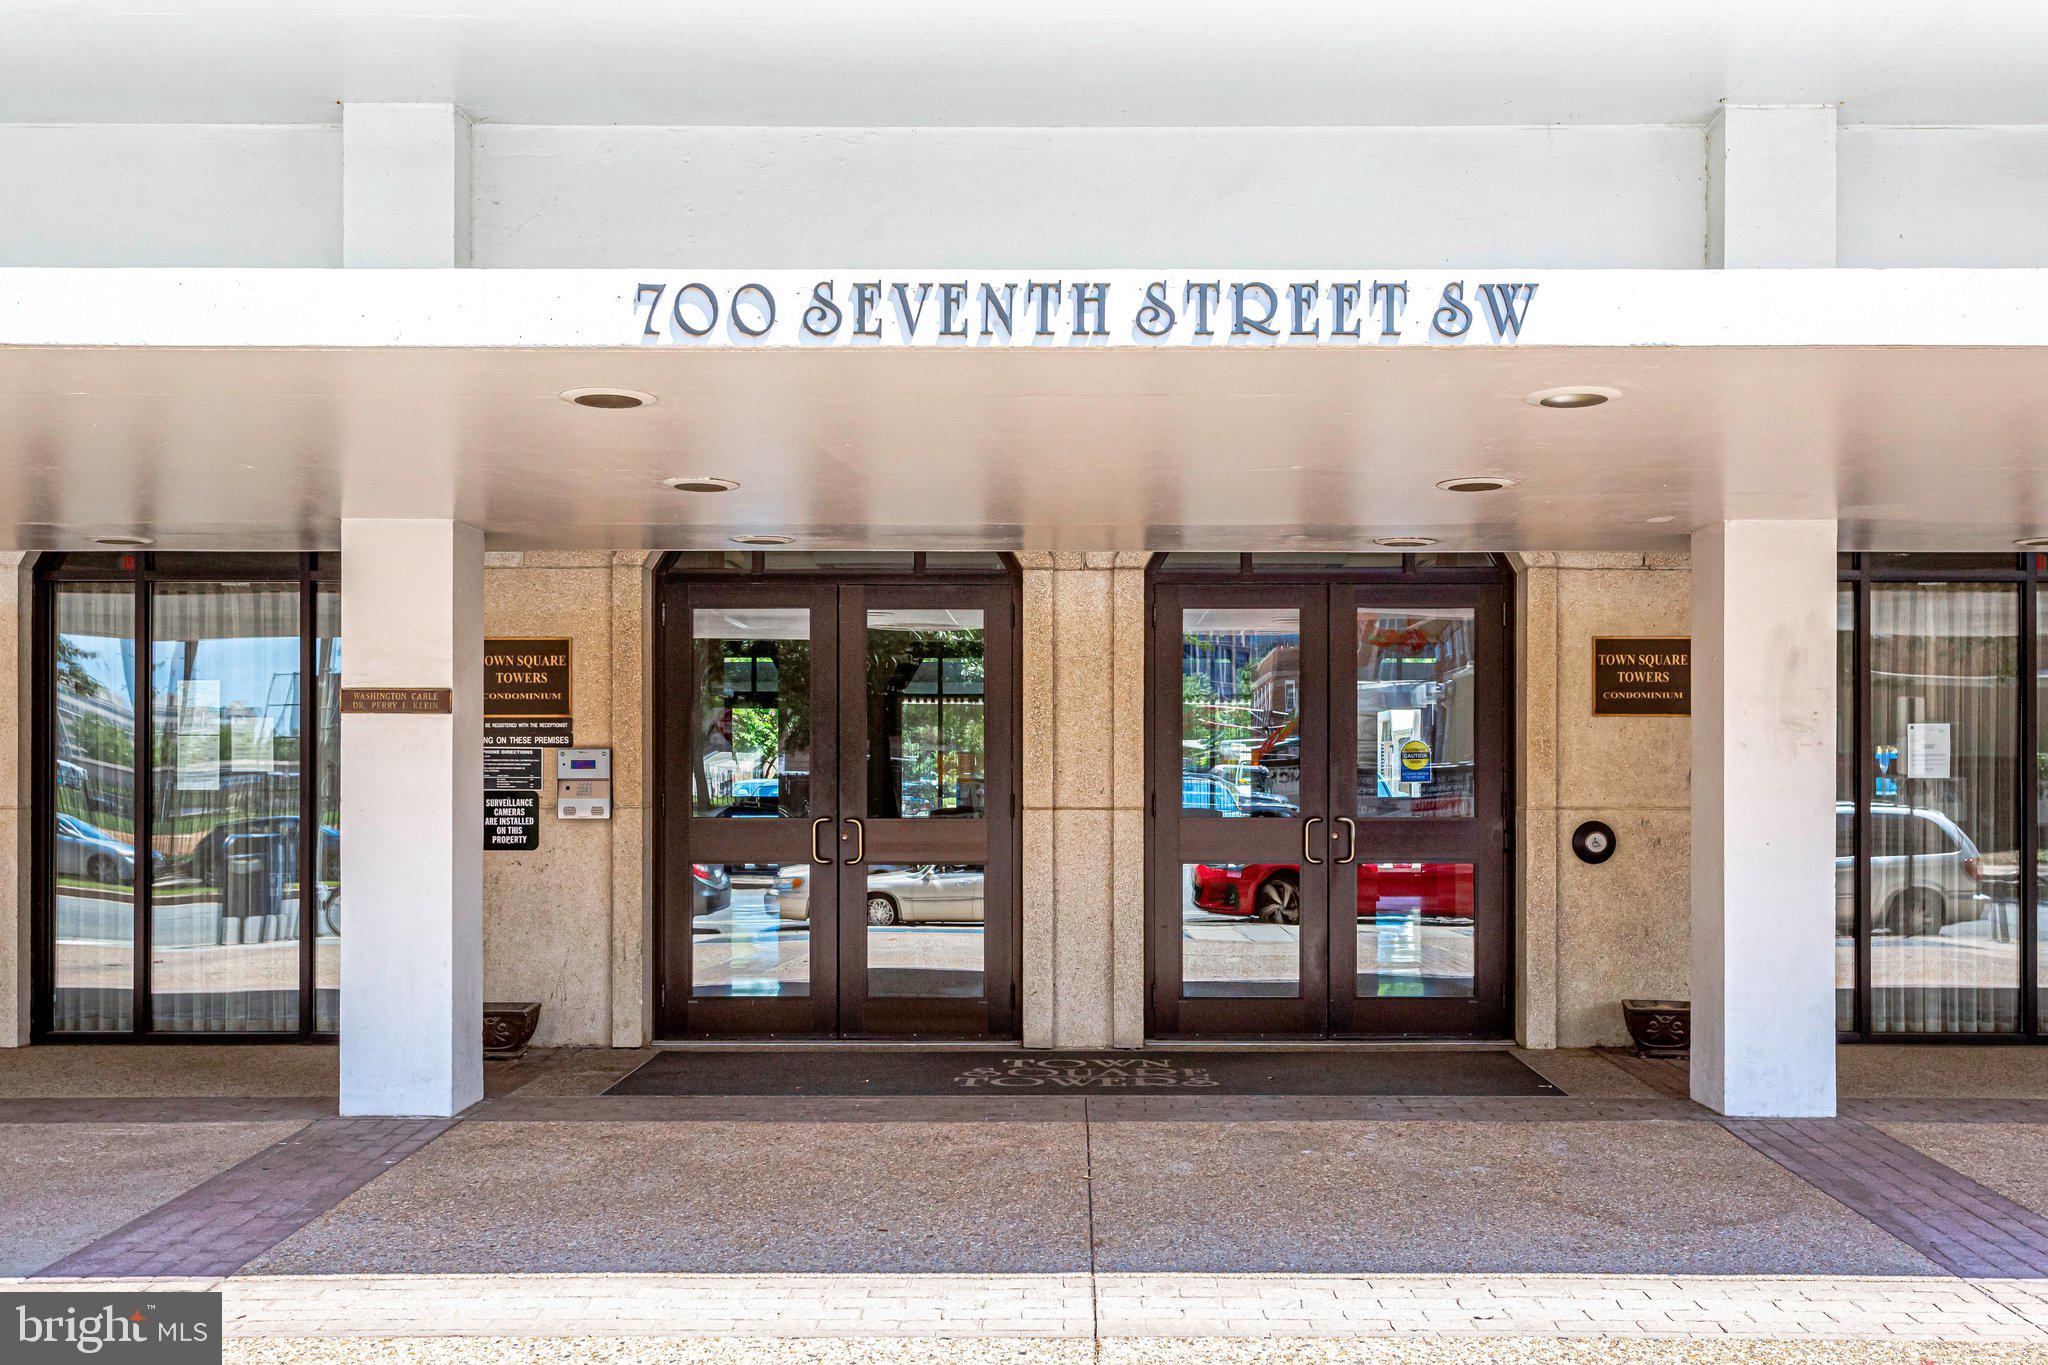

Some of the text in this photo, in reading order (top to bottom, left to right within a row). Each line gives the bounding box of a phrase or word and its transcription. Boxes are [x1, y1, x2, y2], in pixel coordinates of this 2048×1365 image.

[637, 279, 1539, 338] 700 SEVENTH STREET SW
[484, 655, 567, 668] OWN SQUARE
[1598, 654, 1688, 667] TOWN SQUARE
[495, 672, 548, 684] TOWERS
[1617, 671, 1669, 683] TOWERS
[353, 692, 439, 700] WASHINGTON CABLE
[484, 692, 561, 700] CONDOMINIUM
[1603, 691, 1683, 699] CONDOMINIUM
[371, 701, 397, 710] PERRY
[413, 701, 439, 710] KLEIN
[496, 736, 507, 744] ON
[509, 736, 532, 744] THESE
[534, 736, 570, 744] PREMISES
[485, 798, 534, 807] SURVEILLANCE
[493, 808, 526, 816] CAMERAS
[484, 817, 534, 826] ARE INSTALLED
[496, 826, 523, 835] ON THIS
[492, 835, 528, 844] PROPERTY
[1002, 1059, 1172, 1068] TOWN
